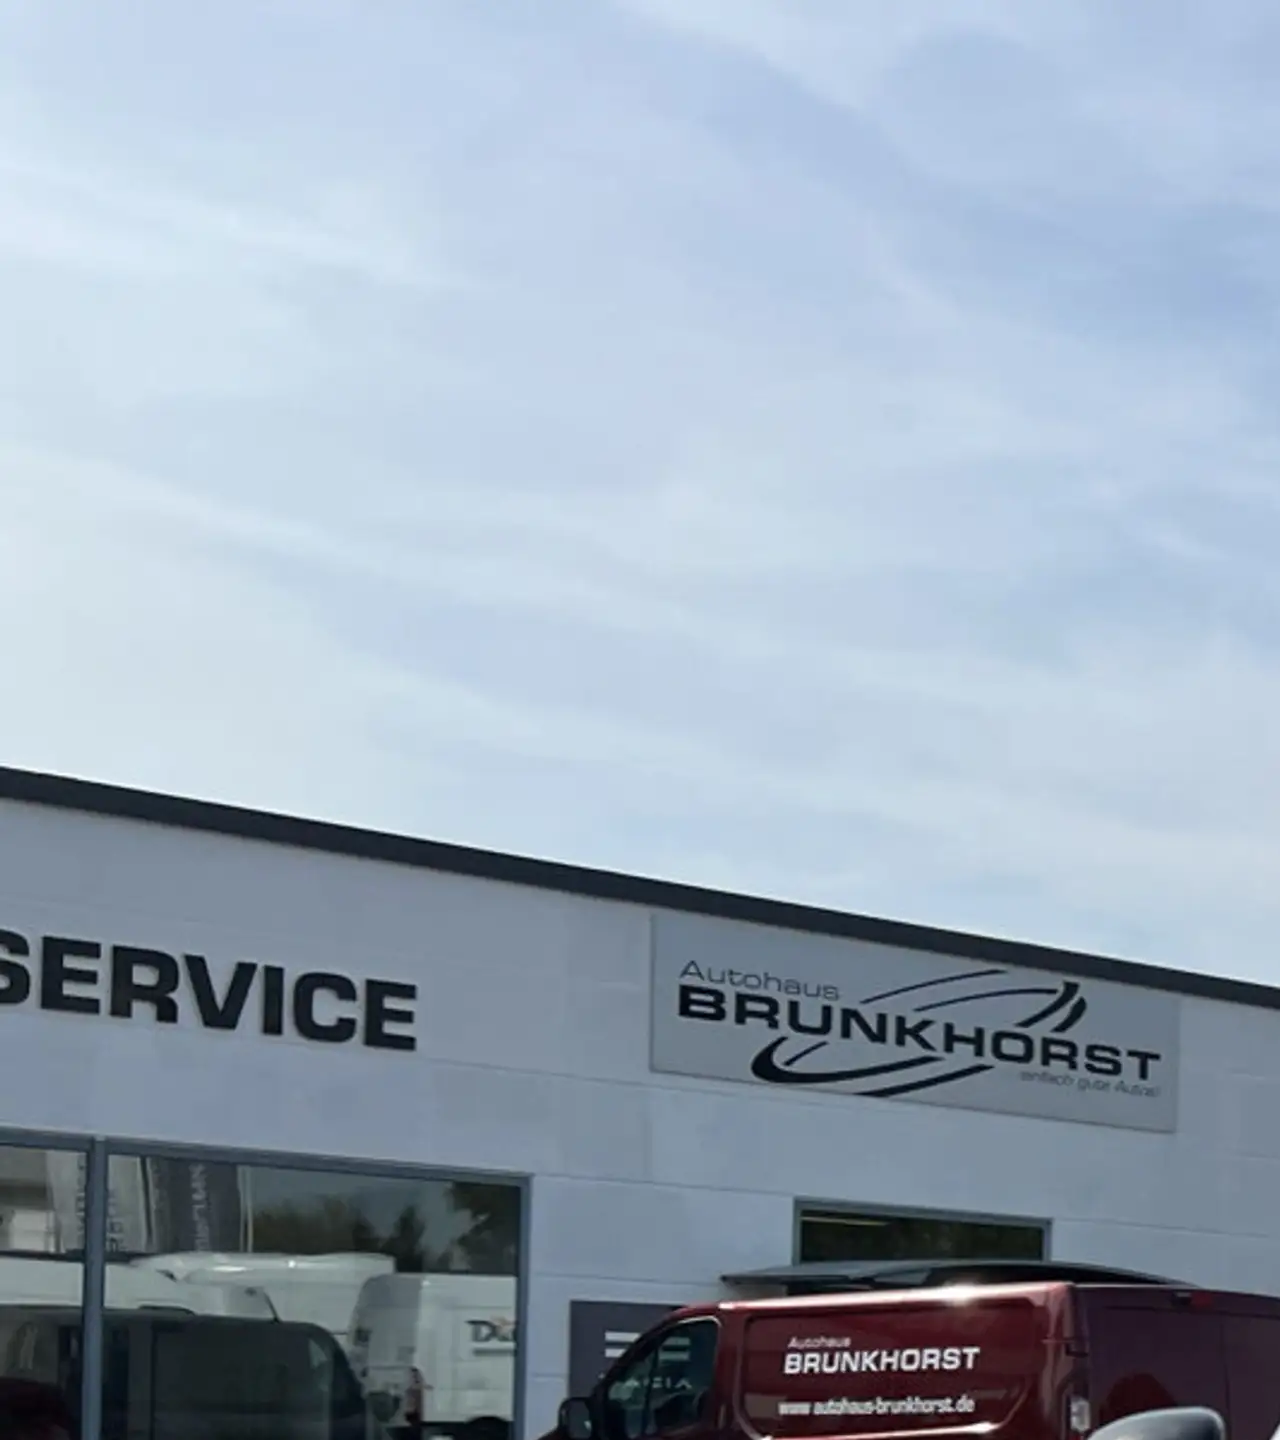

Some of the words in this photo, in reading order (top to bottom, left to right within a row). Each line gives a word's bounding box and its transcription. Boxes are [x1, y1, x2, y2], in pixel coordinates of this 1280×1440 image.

[680, 959, 840, 1001] Autohaus
[678, 984, 1162, 1081] BRUNKHORST
[787, 1336, 851, 1349] Autohaus
[784, 1346, 980, 1375] BRUNKHORST
